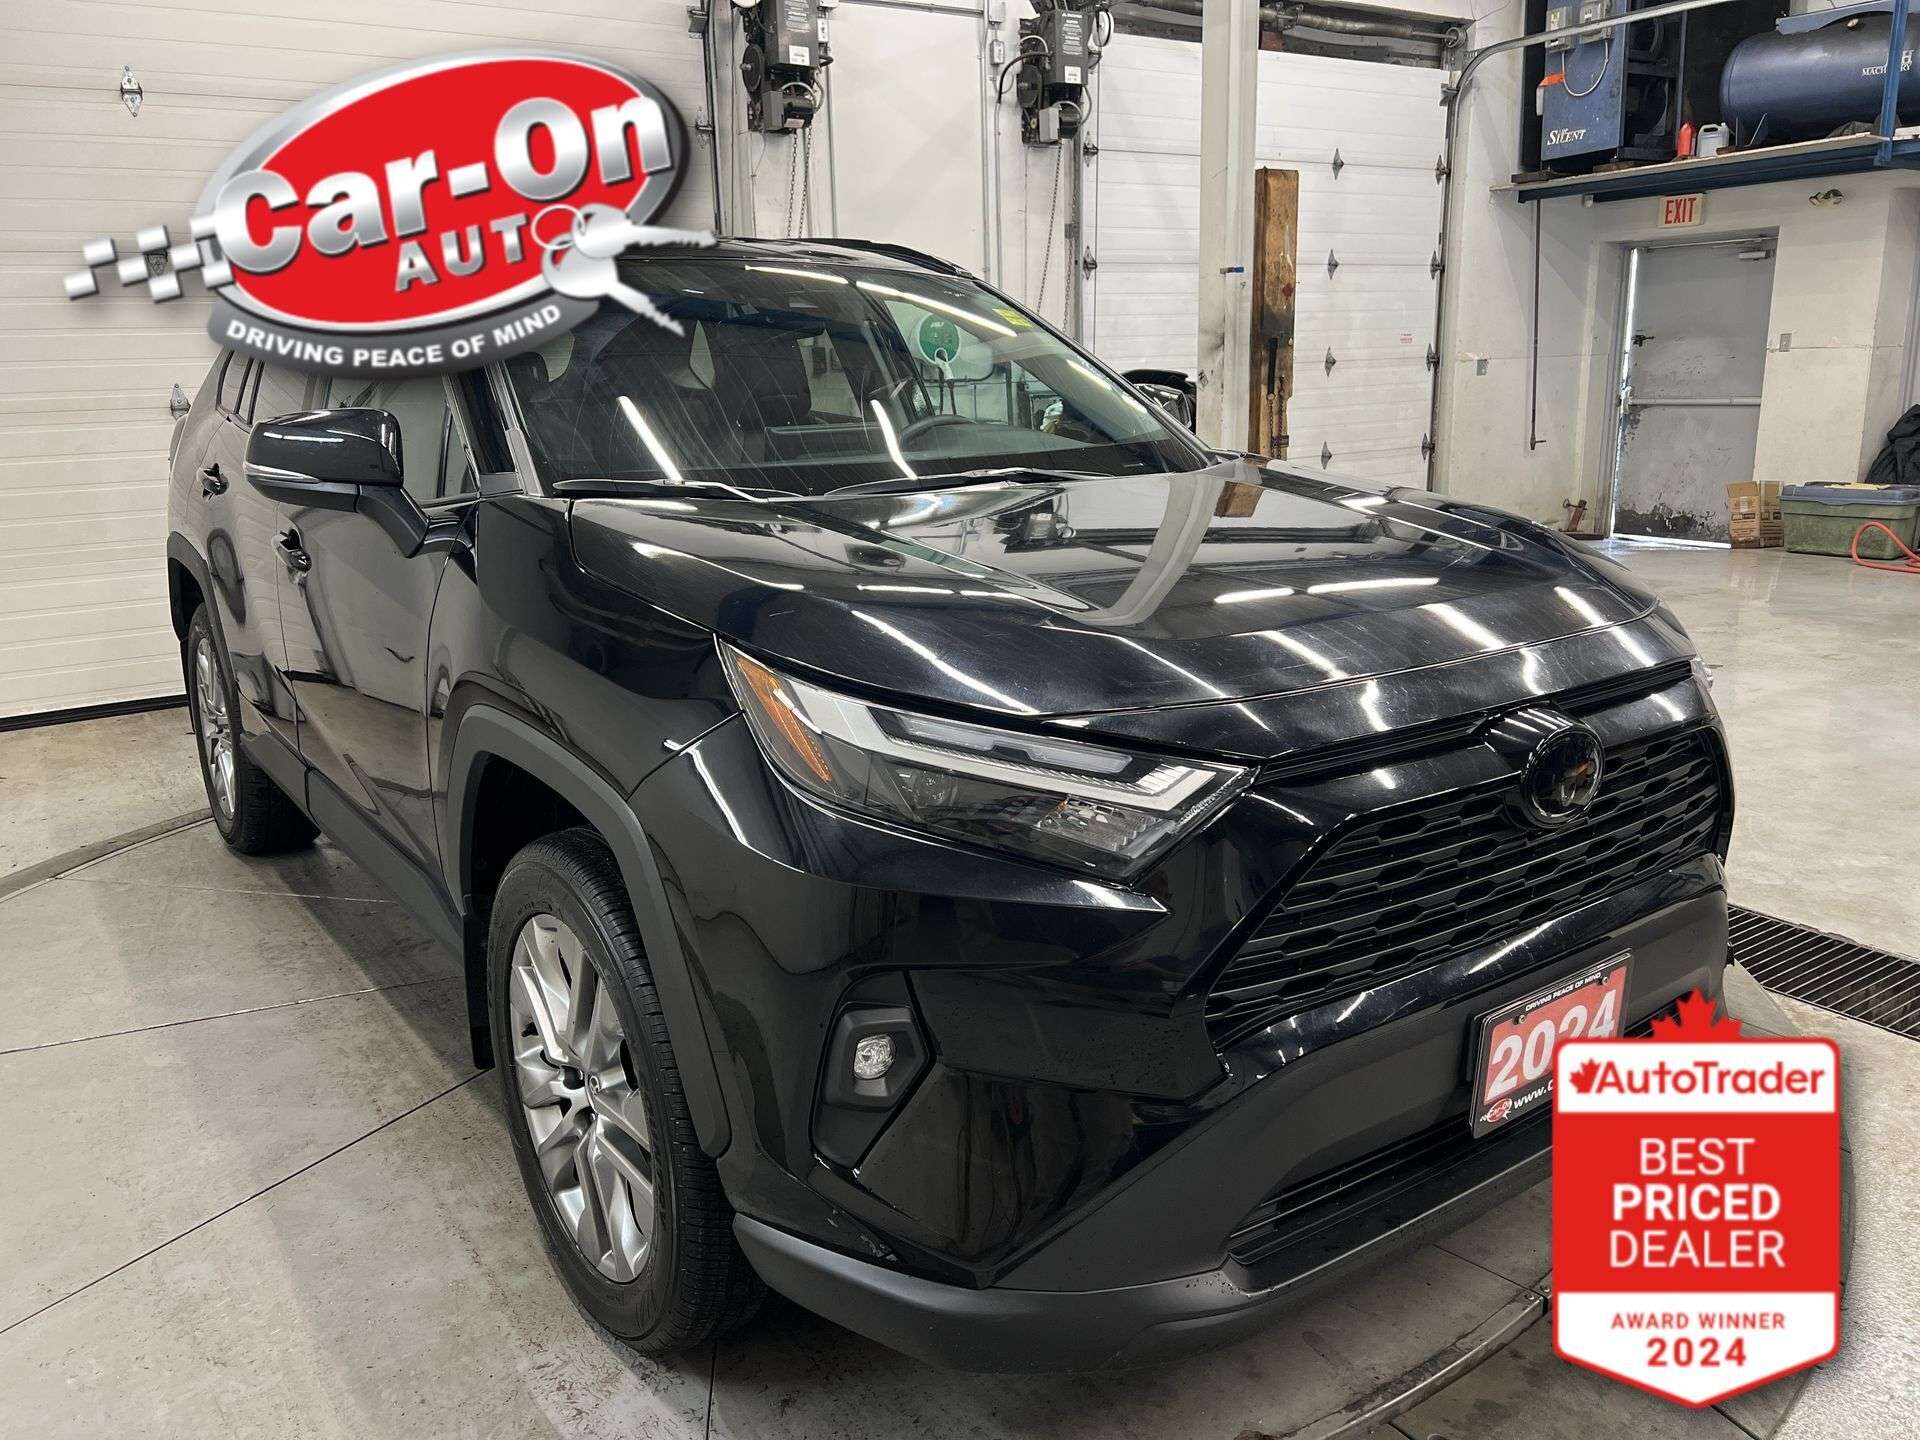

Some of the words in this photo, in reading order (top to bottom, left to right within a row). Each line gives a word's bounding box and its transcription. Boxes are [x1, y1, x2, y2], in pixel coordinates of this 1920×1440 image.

[1862, 62, 1912, 76] MACHRY
[1664, 197, 1697, 224] EXIT
[1525, 994, 1552, 1012] DRIVING
[1553, 984, 1575, 998] PEACE
[1575, 979, 1585, 988] OF
[1584, 972, 1601, 984] MIND
